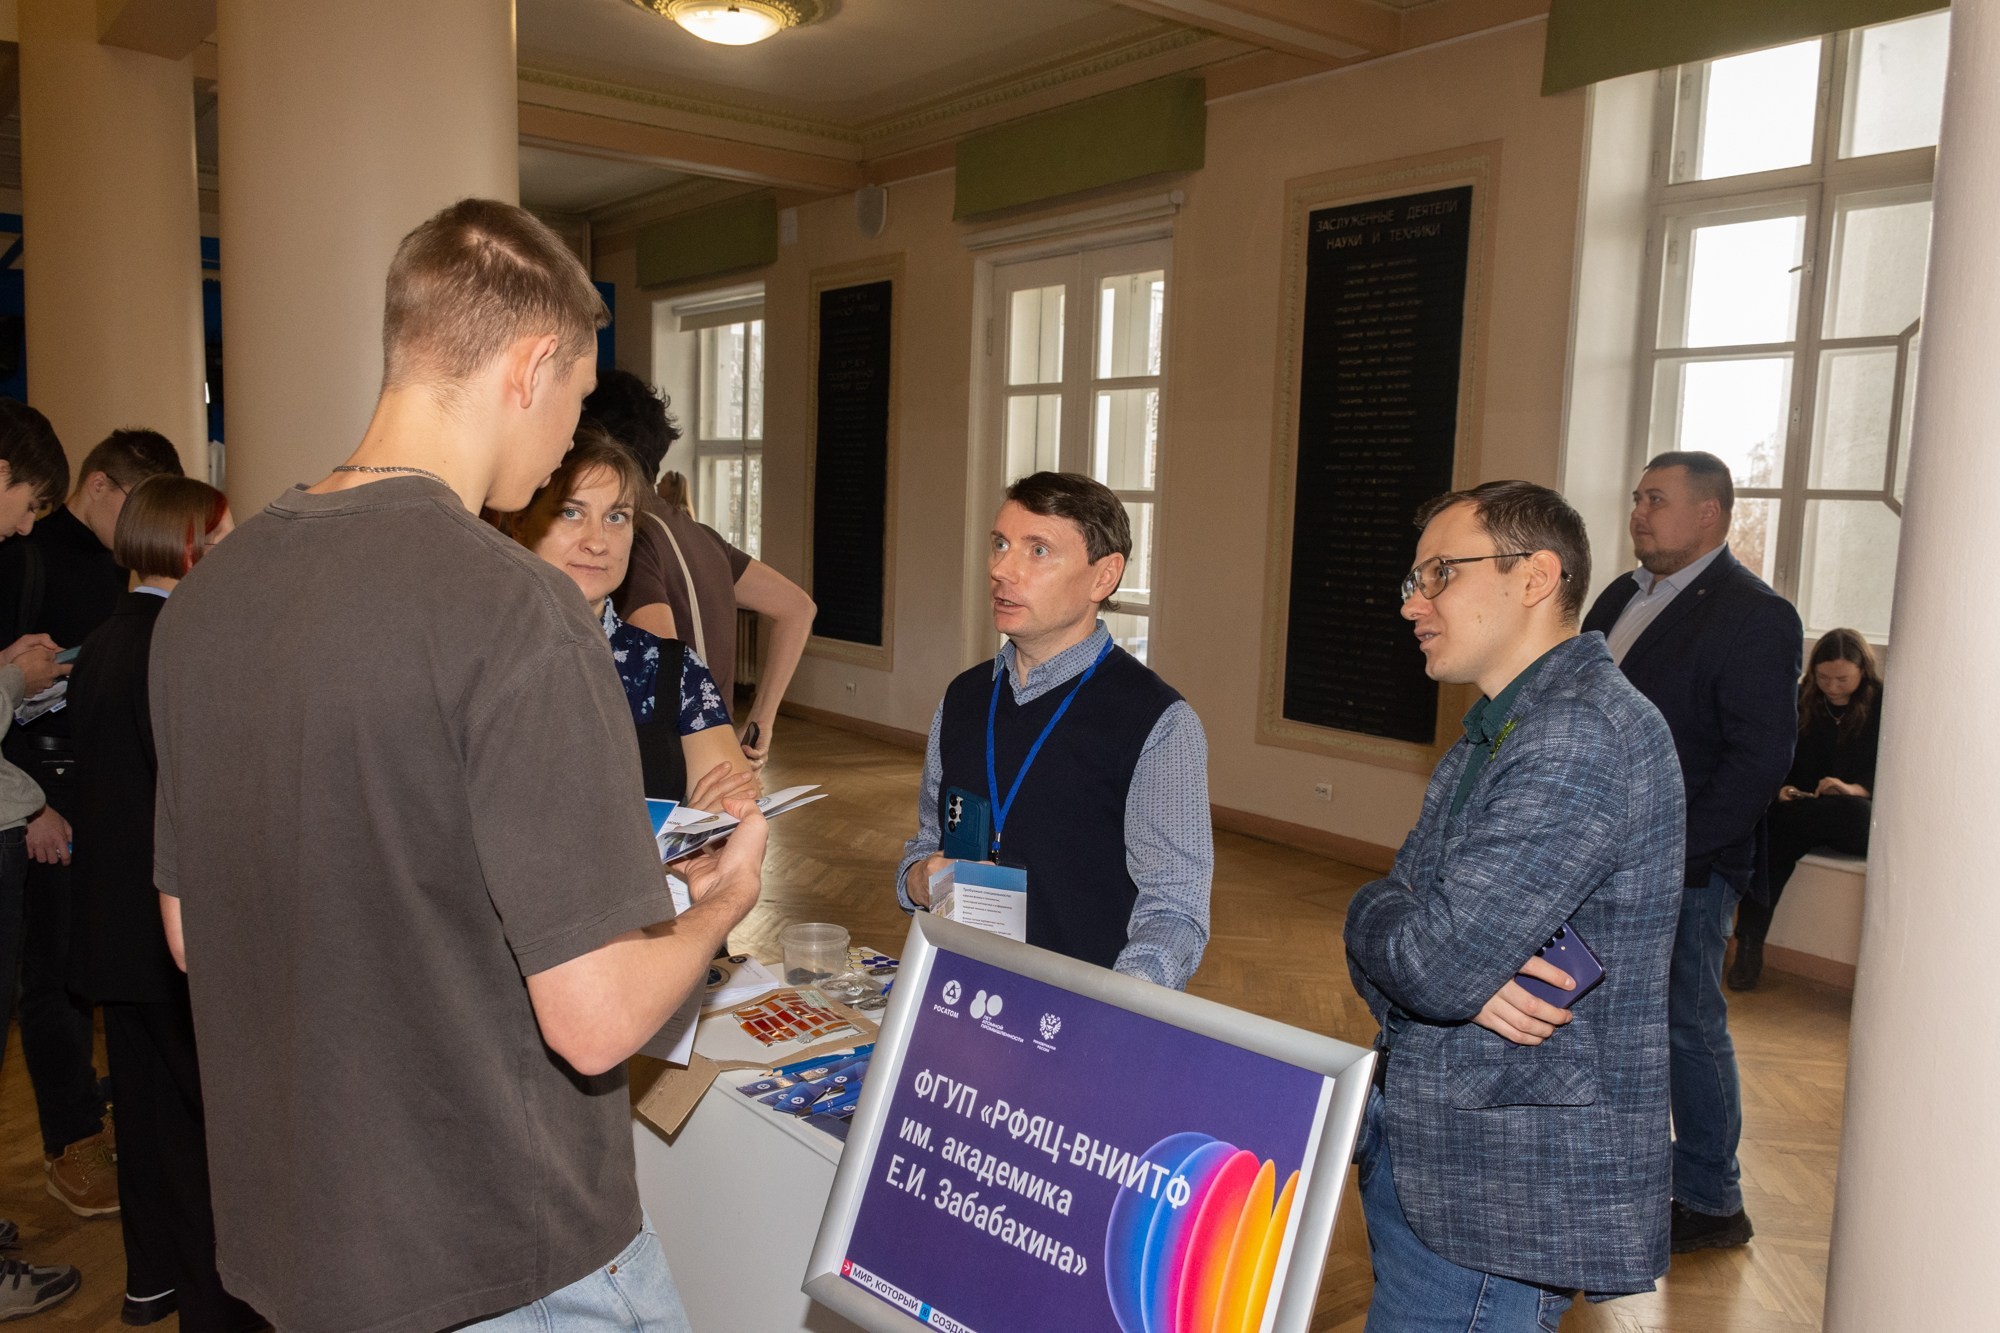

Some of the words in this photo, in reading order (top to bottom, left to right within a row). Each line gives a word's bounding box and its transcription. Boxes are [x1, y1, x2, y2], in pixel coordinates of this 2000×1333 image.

[1315, 209, 1395, 233] ЗАСЛУЖЕННЫЕ
[1406, 200, 1458, 220] ДЕЯТЕЛИ
[1326, 234, 1363, 250] НАУКИ
[1371, 233, 1381, 245] И
[1389, 223, 1442, 241] ТЕХНИКИ
[933, 1004, 959, 1019] РОСАТОМ
[913, 1068, 978, 1118] ФГУП
[980, 1099, 1191, 1210] «РФЯЦ-ВНИИТФ
[899, 1117, 935, 1152] им.
[941, 1136, 1073, 1217] академика
[886, 1153, 927, 1201] Е.И.
[934, 1178, 1088, 1277] Забабахина»
[852, 1267, 874, 1287] МИР,
[874, 1279, 919, 1312] КОТОРЫЙ
